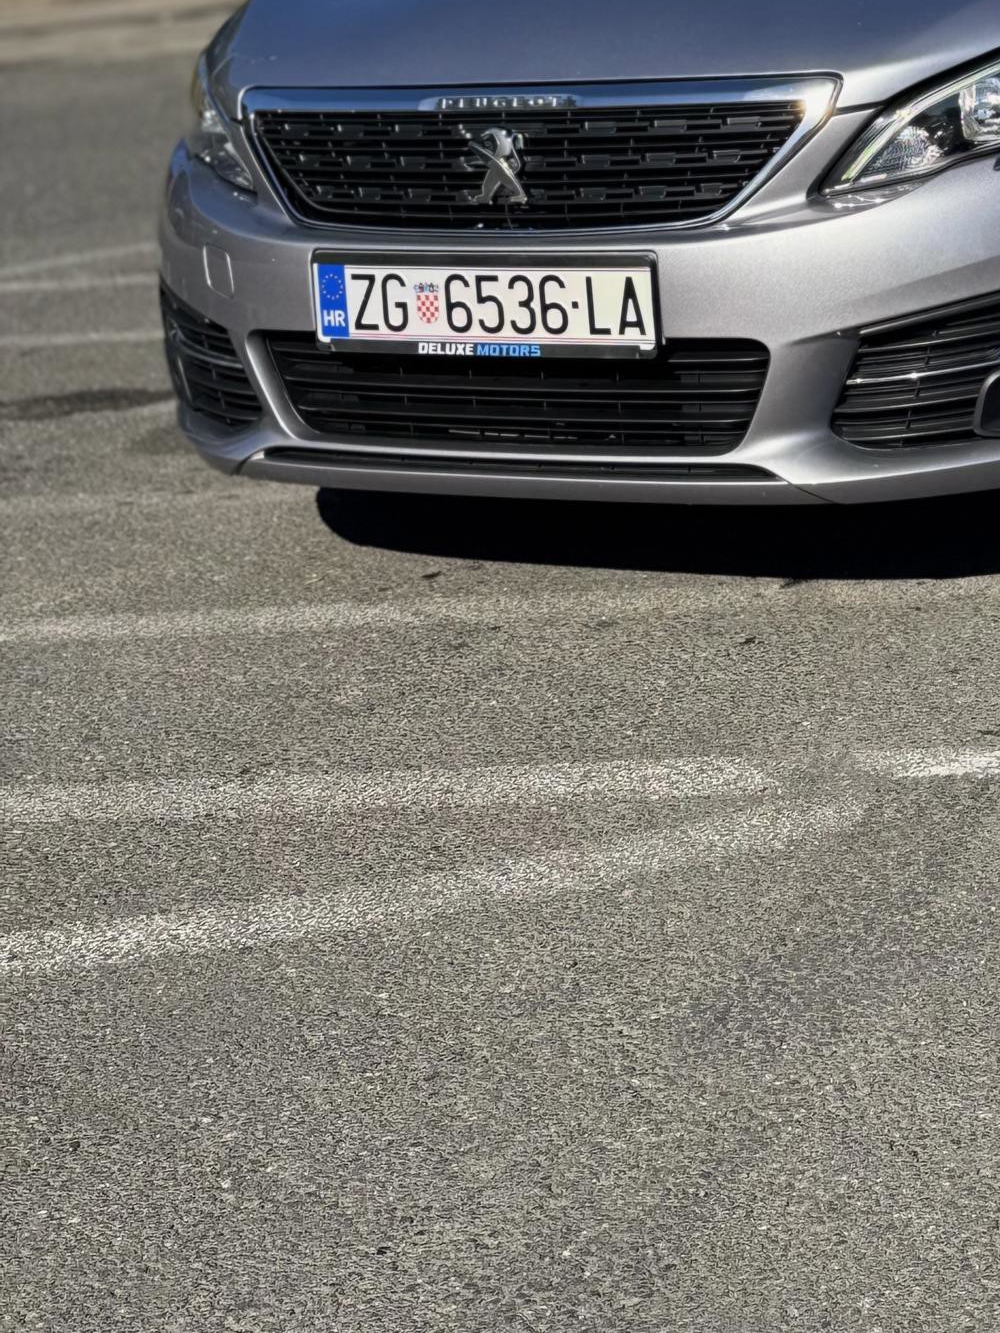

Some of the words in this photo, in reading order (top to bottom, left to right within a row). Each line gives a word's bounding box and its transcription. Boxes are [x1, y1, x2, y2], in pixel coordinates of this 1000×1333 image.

[350, 273, 409, 332] ZG
[323, 310, 346, 327] HR
[418, 342, 474, 356] DELUXE
[476, 343, 541, 357] MOTORS
